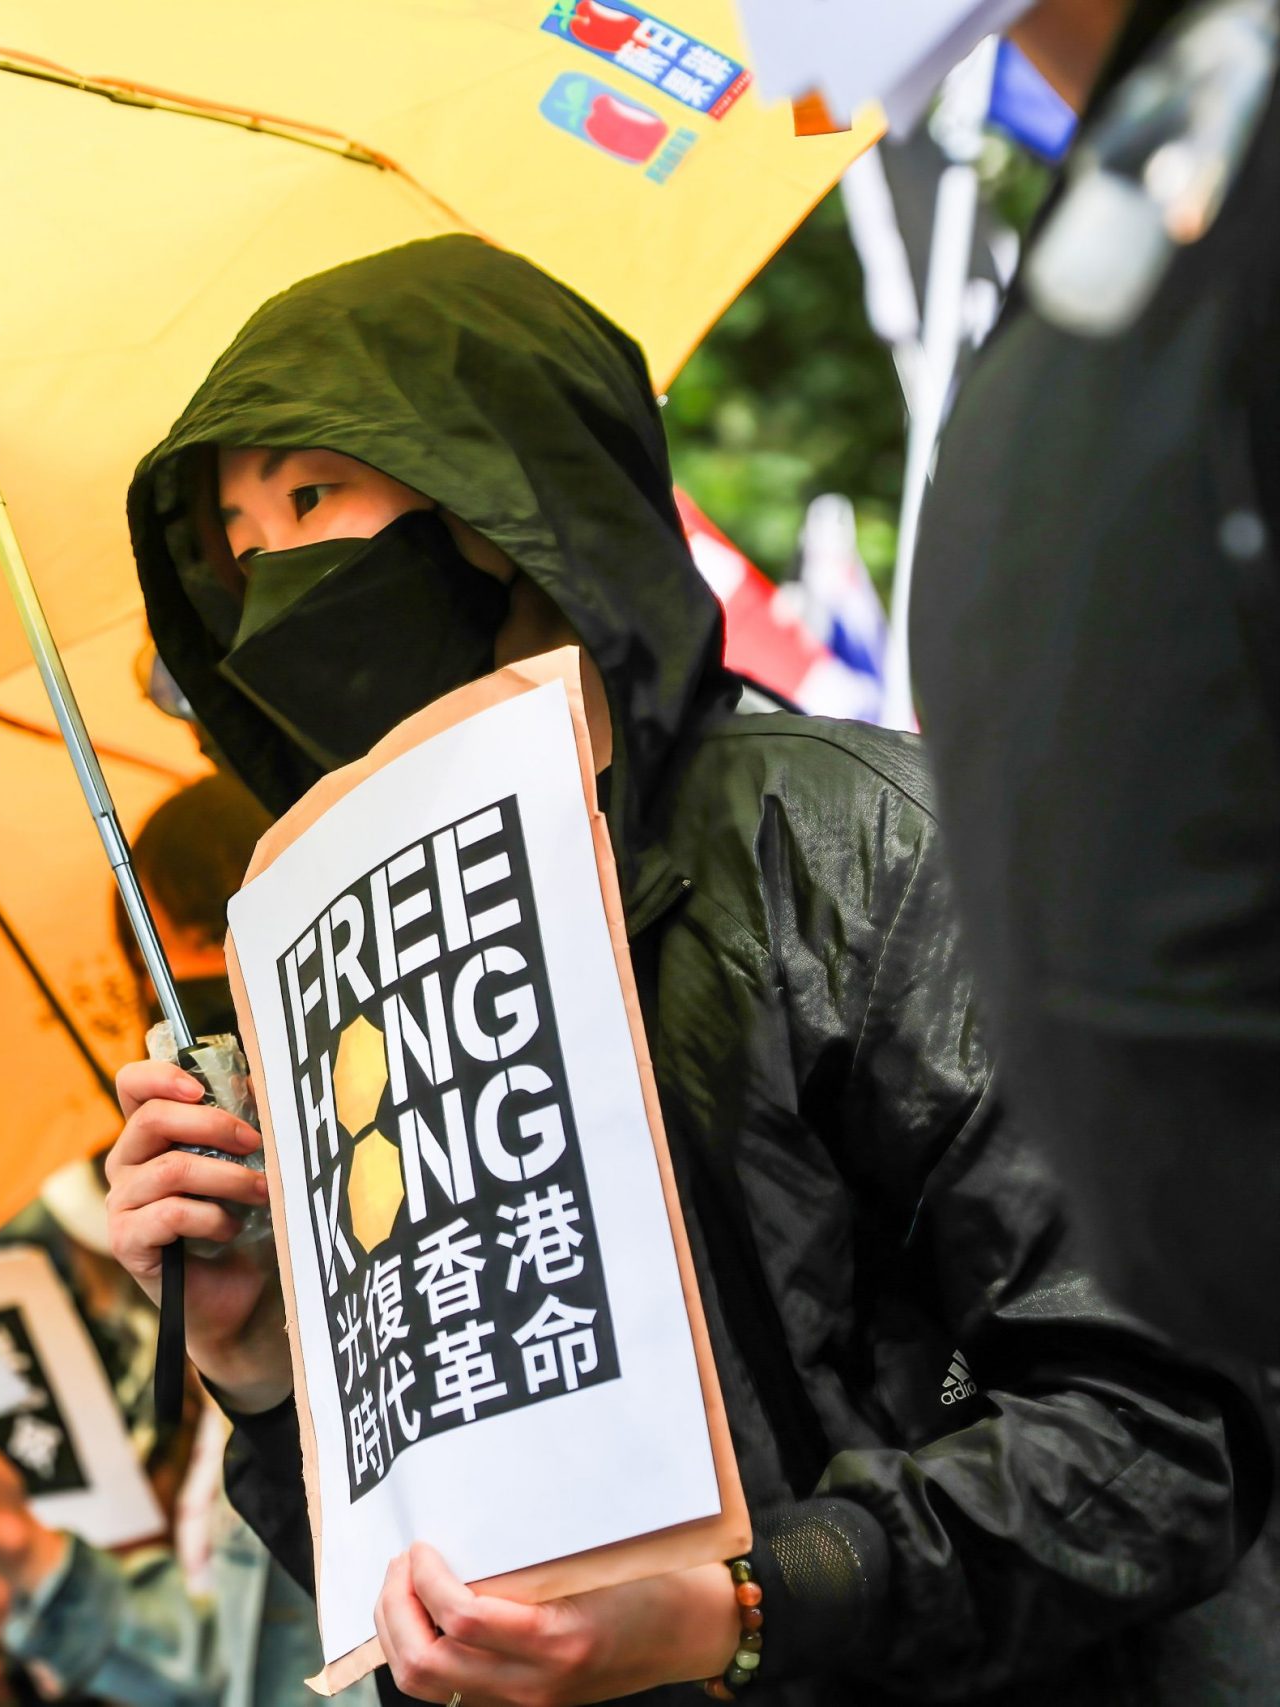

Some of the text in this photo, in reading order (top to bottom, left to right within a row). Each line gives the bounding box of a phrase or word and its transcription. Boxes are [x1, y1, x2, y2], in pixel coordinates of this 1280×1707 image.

[284, 806, 521, 1066] FREE
[337, 1184, 584, 1396] 光復香港
[349, 1294, 598, 1486] 時代革命
